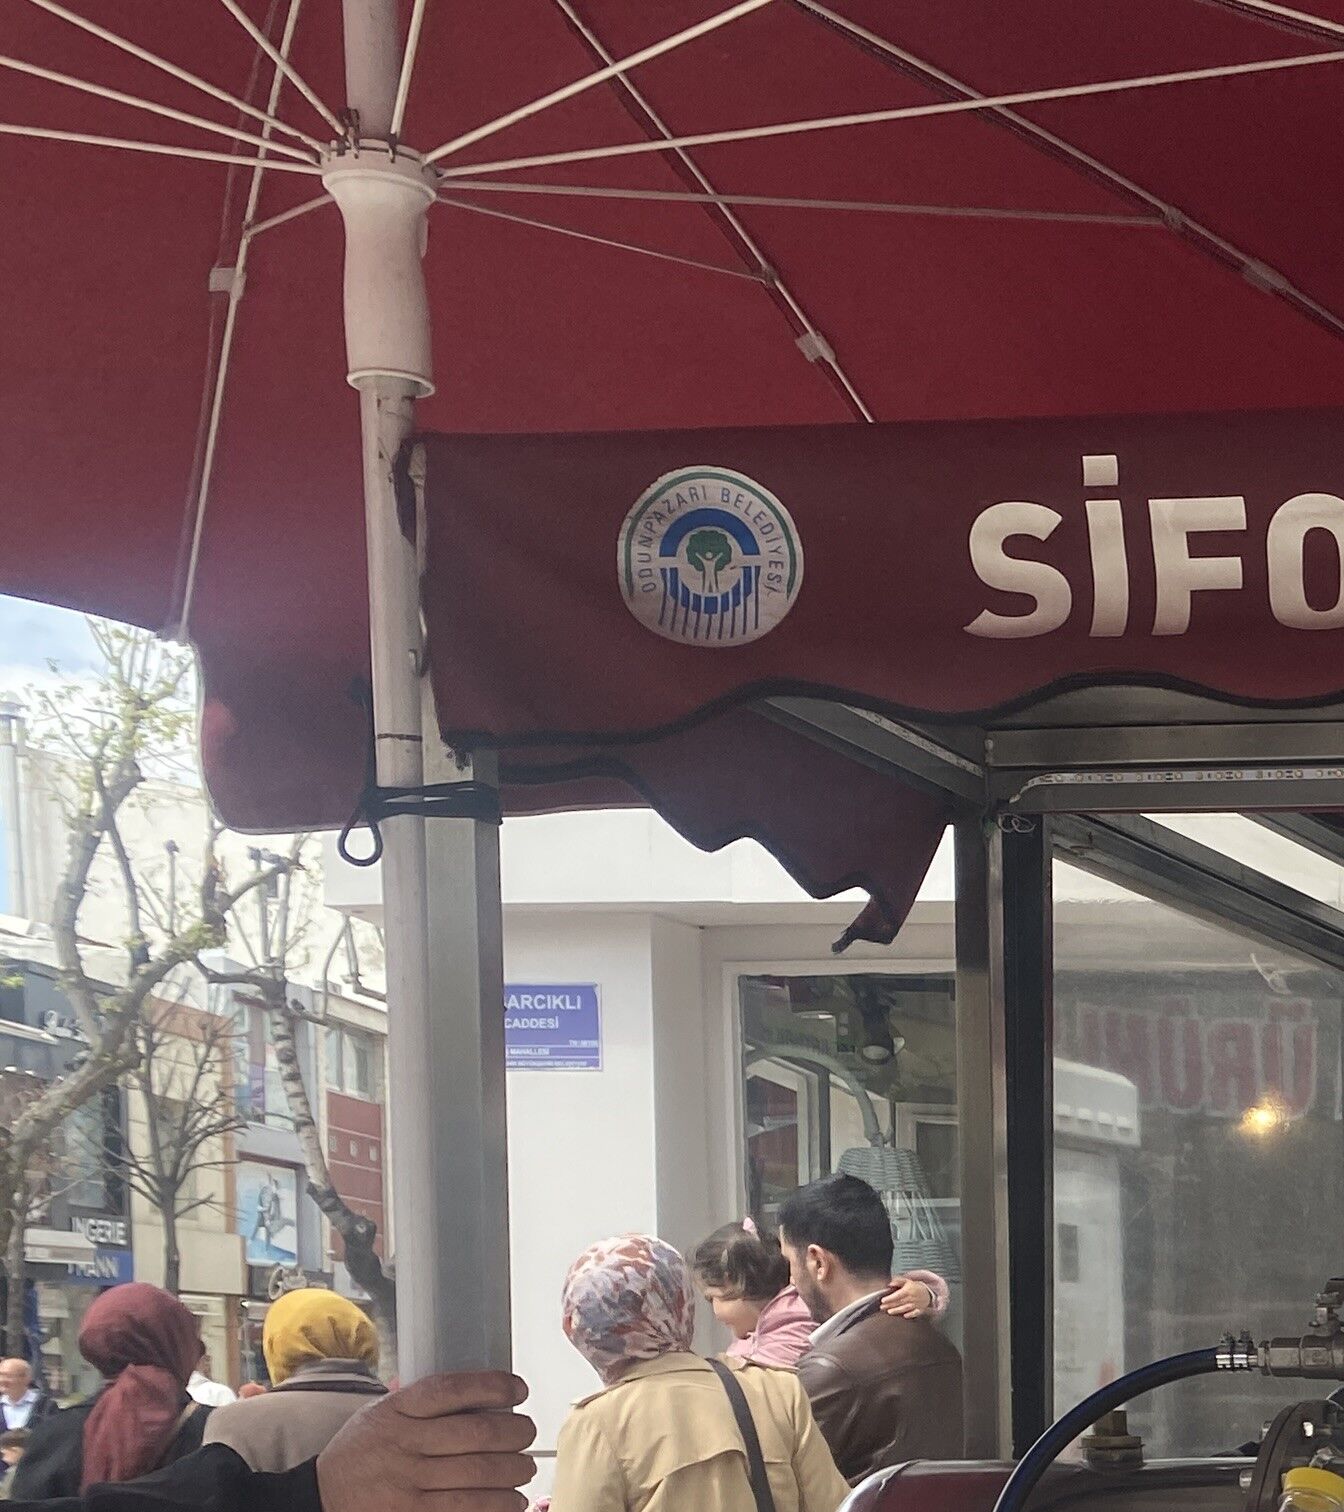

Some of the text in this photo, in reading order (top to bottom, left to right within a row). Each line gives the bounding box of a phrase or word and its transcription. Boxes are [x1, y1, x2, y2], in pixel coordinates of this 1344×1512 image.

[637, 485, 784, 597] ODUNPAZARI BELEDİYESİ
[504, 994, 582, 1009] ARCIKLI
[505, 1016, 559, 1029] CADDESİ
